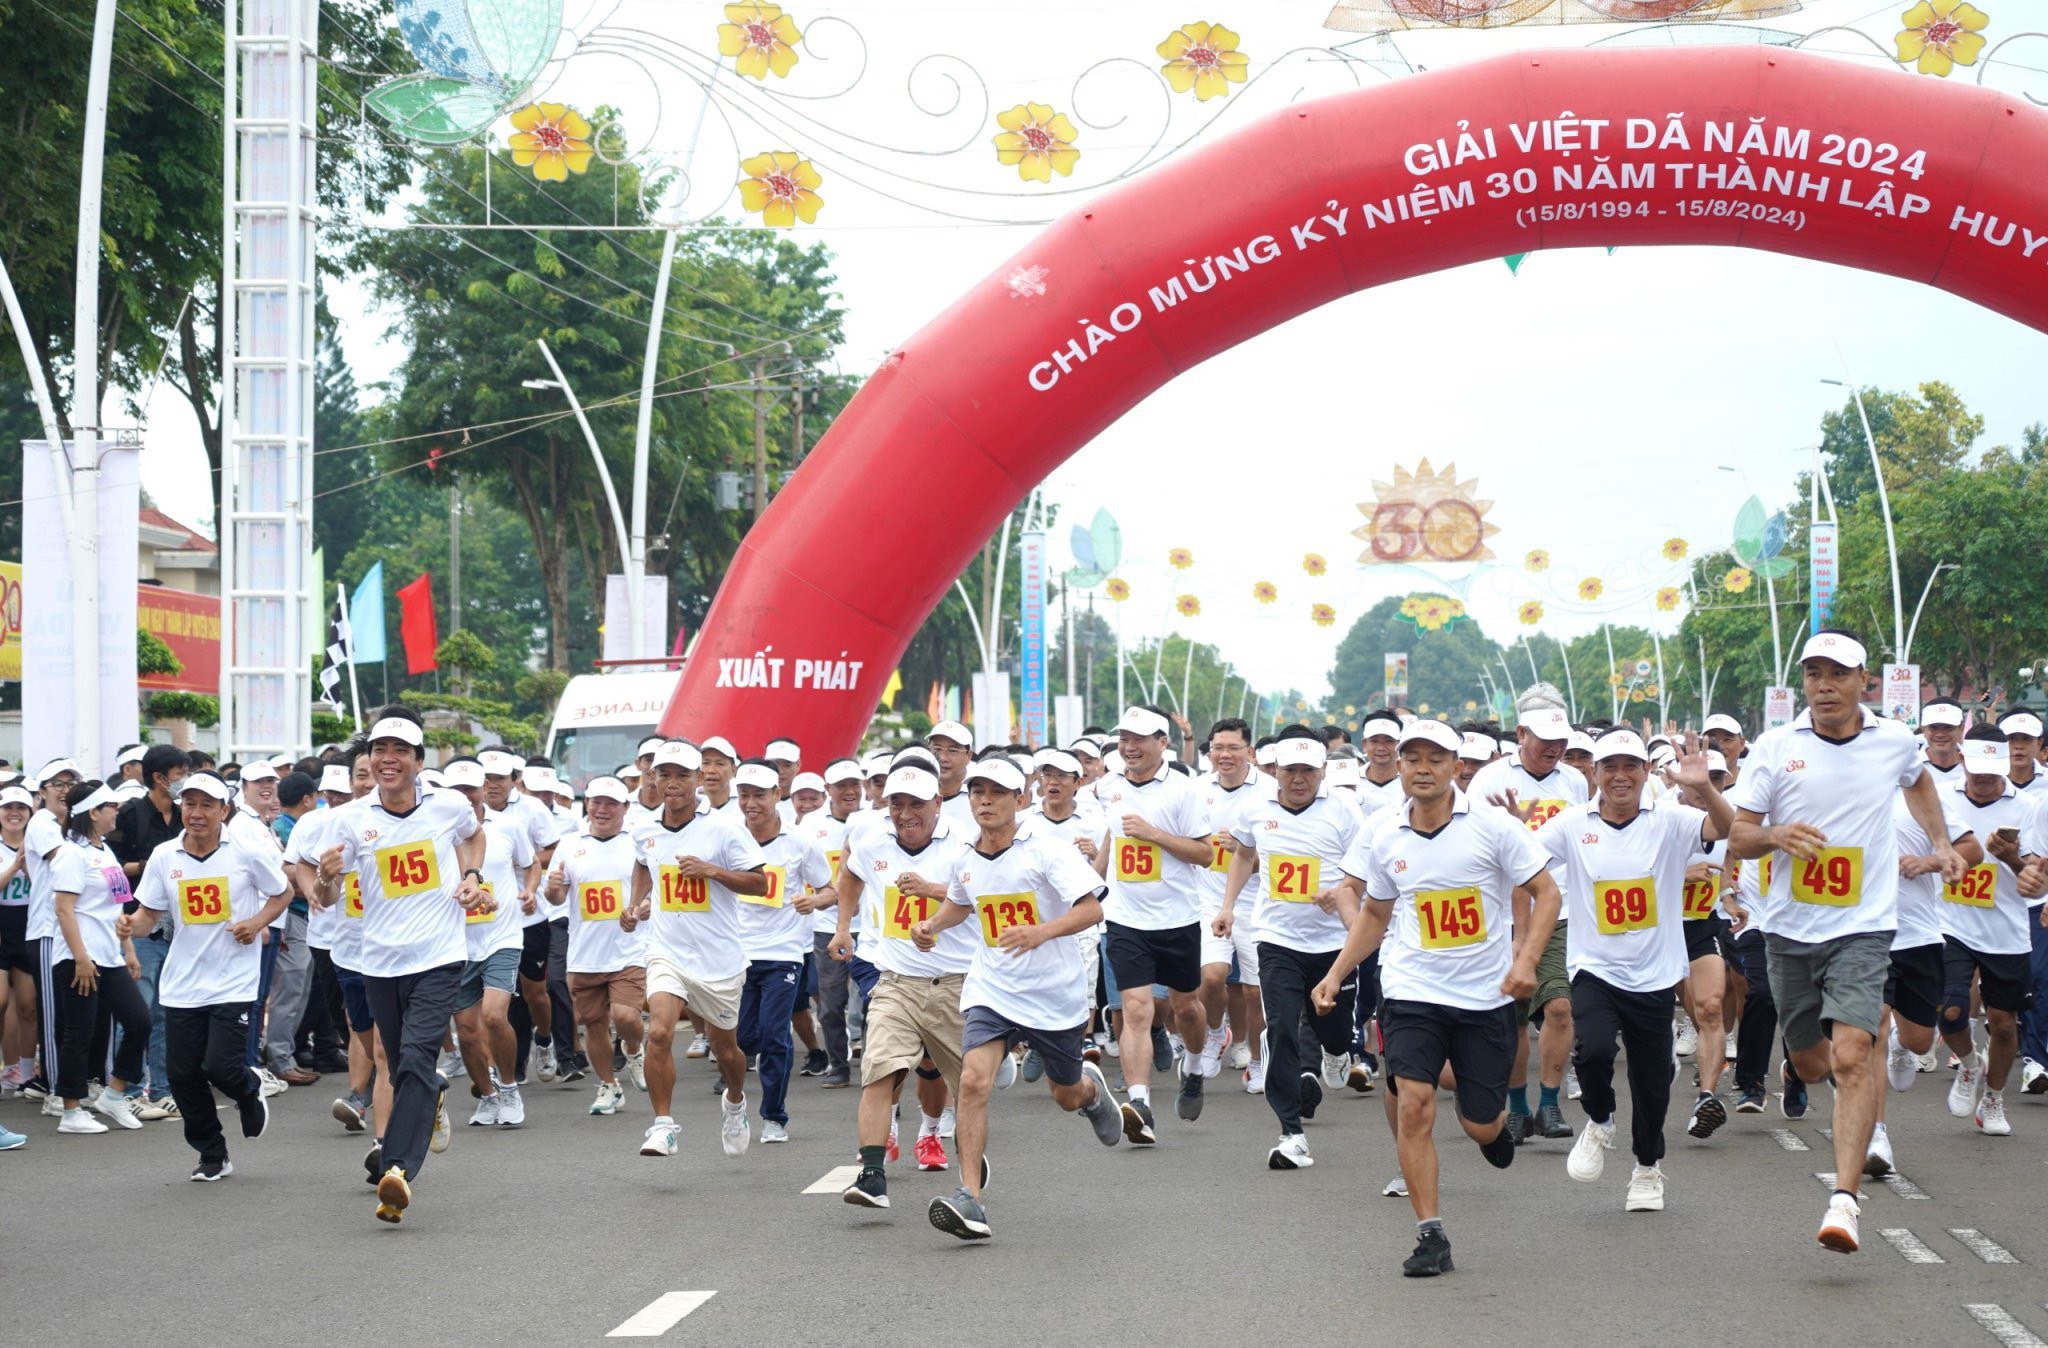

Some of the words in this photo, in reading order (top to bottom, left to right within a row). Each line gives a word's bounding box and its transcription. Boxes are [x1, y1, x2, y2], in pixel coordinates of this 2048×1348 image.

[1403, 119, 1496, 177] GIẢI
[1508, 109, 1610, 157] VIỆT
[1626, 111, 1691, 150] DÃ
[1703, 116, 1811, 161] NĂM
[1819, 133, 1928, 181] 2024
[1515, 200, 1650, 229] (15/8/1994
[1675, 199, 1807, 231] 15/8/2024)
[1028, 302, 1143, 392] CHÀO
[1148, 235, 1282, 313] MỪNG
[1290, 199, 1352, 250] KỶ
[1363, 181, 1476, 229] NIỆM
[1486, 167, 1538, 198] 30
[1552, 156, 1656, 191] NĂM
[1665, 157, 1829, 202] THÀNH
[1838, 180, 1932, 220] LẬP
[715, 645, 785, 688] XUẤT
[794, 650, 863, 690] PHÁT
[1891, 668, 1912, 682] 30
[1786, 759, 1805, 773] 30
[364, 829, 379, 842] 30
[1264, 820, 1278, 830] 30
[1582, 833, 1599, 844] 30
[170, 869, 183, 880] 30
[389, 849, 430, 888] 45
[873, 860, 888, 871] 30
[1121, 844, 1153, 876] 65
[1394, 860, 1407, 874] 30
[1803, 855, 1851, 897] 49
[662, 872, 706, 905] 140
[1278, 862, 1309, 895] 21
[186, 884, 222, 917] 53
[585, 886, 616, 915] 66
[894, 895, 928, 931] 41
[1605, 887, 1647, 925] 89
[1683, 883, 1714, 912] 12
[982, 901, 1036, 938] 133
[1420, 896, 1480, 940] 145
